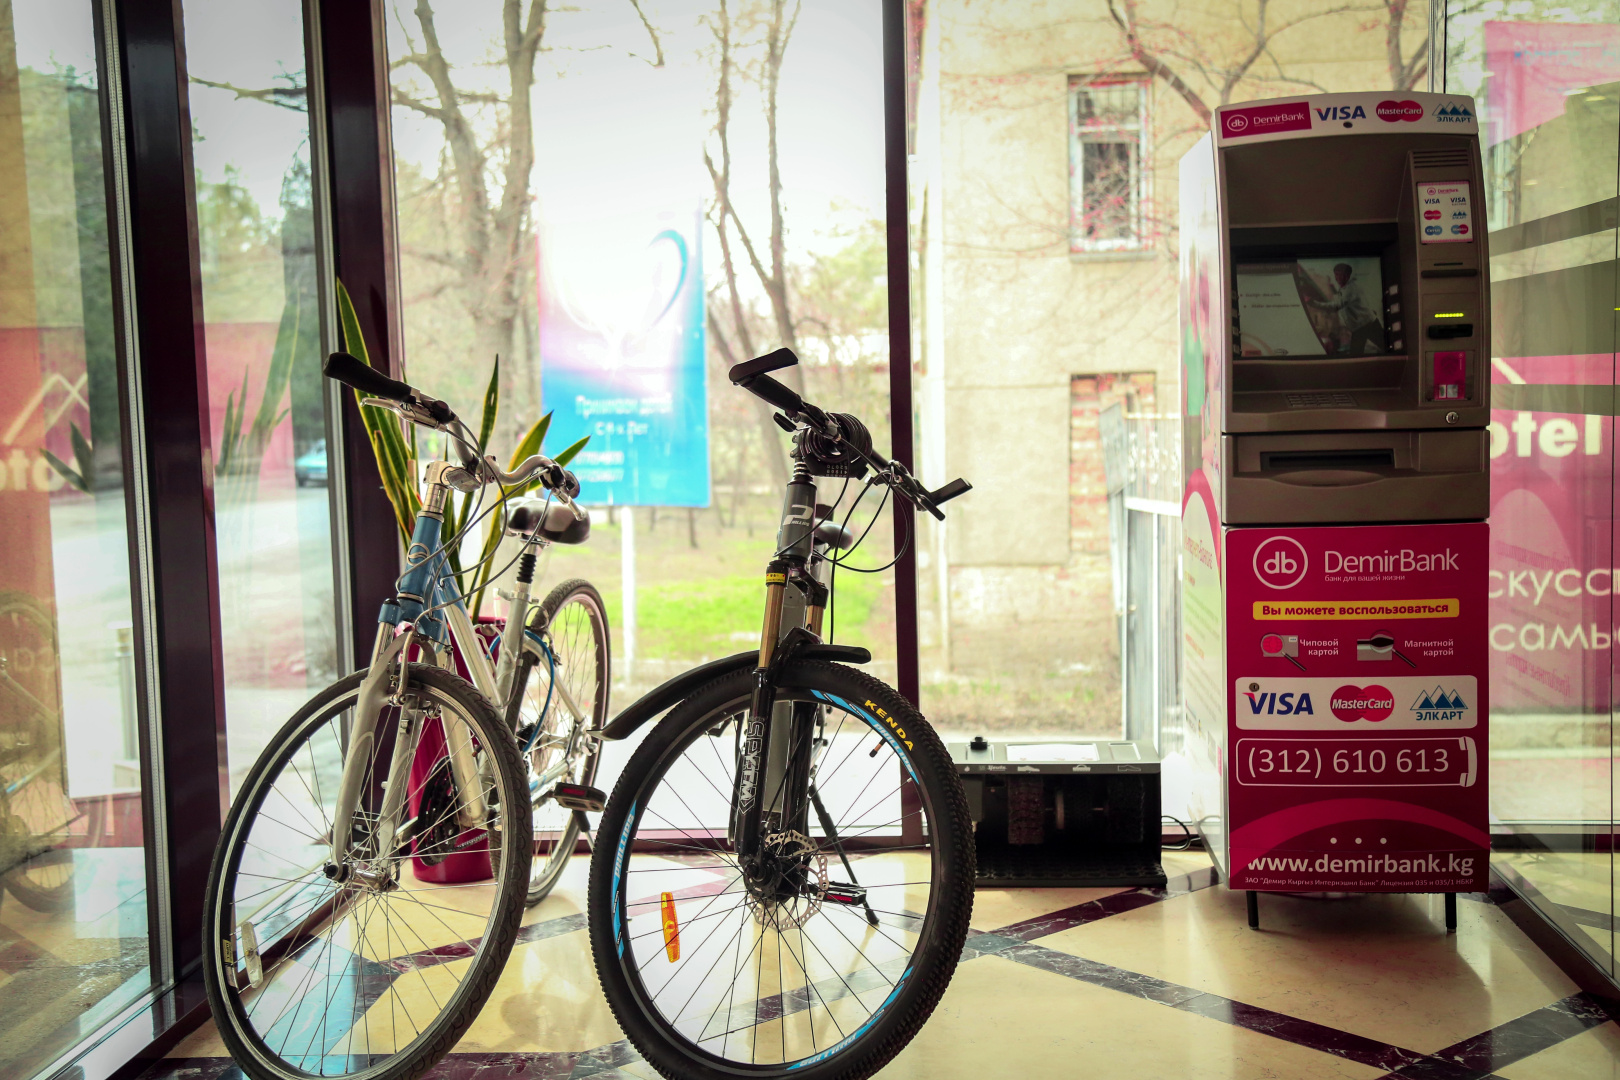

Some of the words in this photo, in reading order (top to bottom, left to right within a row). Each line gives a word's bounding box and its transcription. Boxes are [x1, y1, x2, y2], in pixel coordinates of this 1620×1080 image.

[1313, 105, 1367, 121] VISA
[1377, 106, 1422, 117] MasterCard
[1253, 112, 1305, 125] DemirBank
[1436, 115, 1472, 124] ЭЛКАРТ
[1263, 551, 1298, 575] db
[1324, 548, 1460, 574] DemirBank
[1324, 574, 1342, 582] банк
[1343, 575, 1357, 583] для
[1358, 574, 1381, 582] вашей
[1262, 605, 1281, 616] Вы
[1284, 606, 1336, 616] можете
[1339, 604, 1449, 615] воспользоваться
[1300, 639, 1339, 647] Чиповой
[1404, 639, 1454, 648] Магнитной
[1308, 648, 1339, 657] картой
[1423, 648, 1454, 657] картой
[1242, 692, 1314, 716] VISA
[1331, 698, 1393, 710] MasterCard
[1415, 711, 1464, 721] ЭЛКАРТ
[864, 700, 914, 751] KENDA
[873, 723, 913, 773] PHILLIPS
[1248, 747, 1322, 778] (312)
[1333, 749, 1387, 773] 610
[1396, 748, 1449, 773] 613
[615, 814, 635, 879] PHILLIPS
[1248, 854, 1474, 876] www.demirbank.kg
[1380, 879, 1413, 887] Лицензия
[1435, 878, 1454, 886] 035/1
